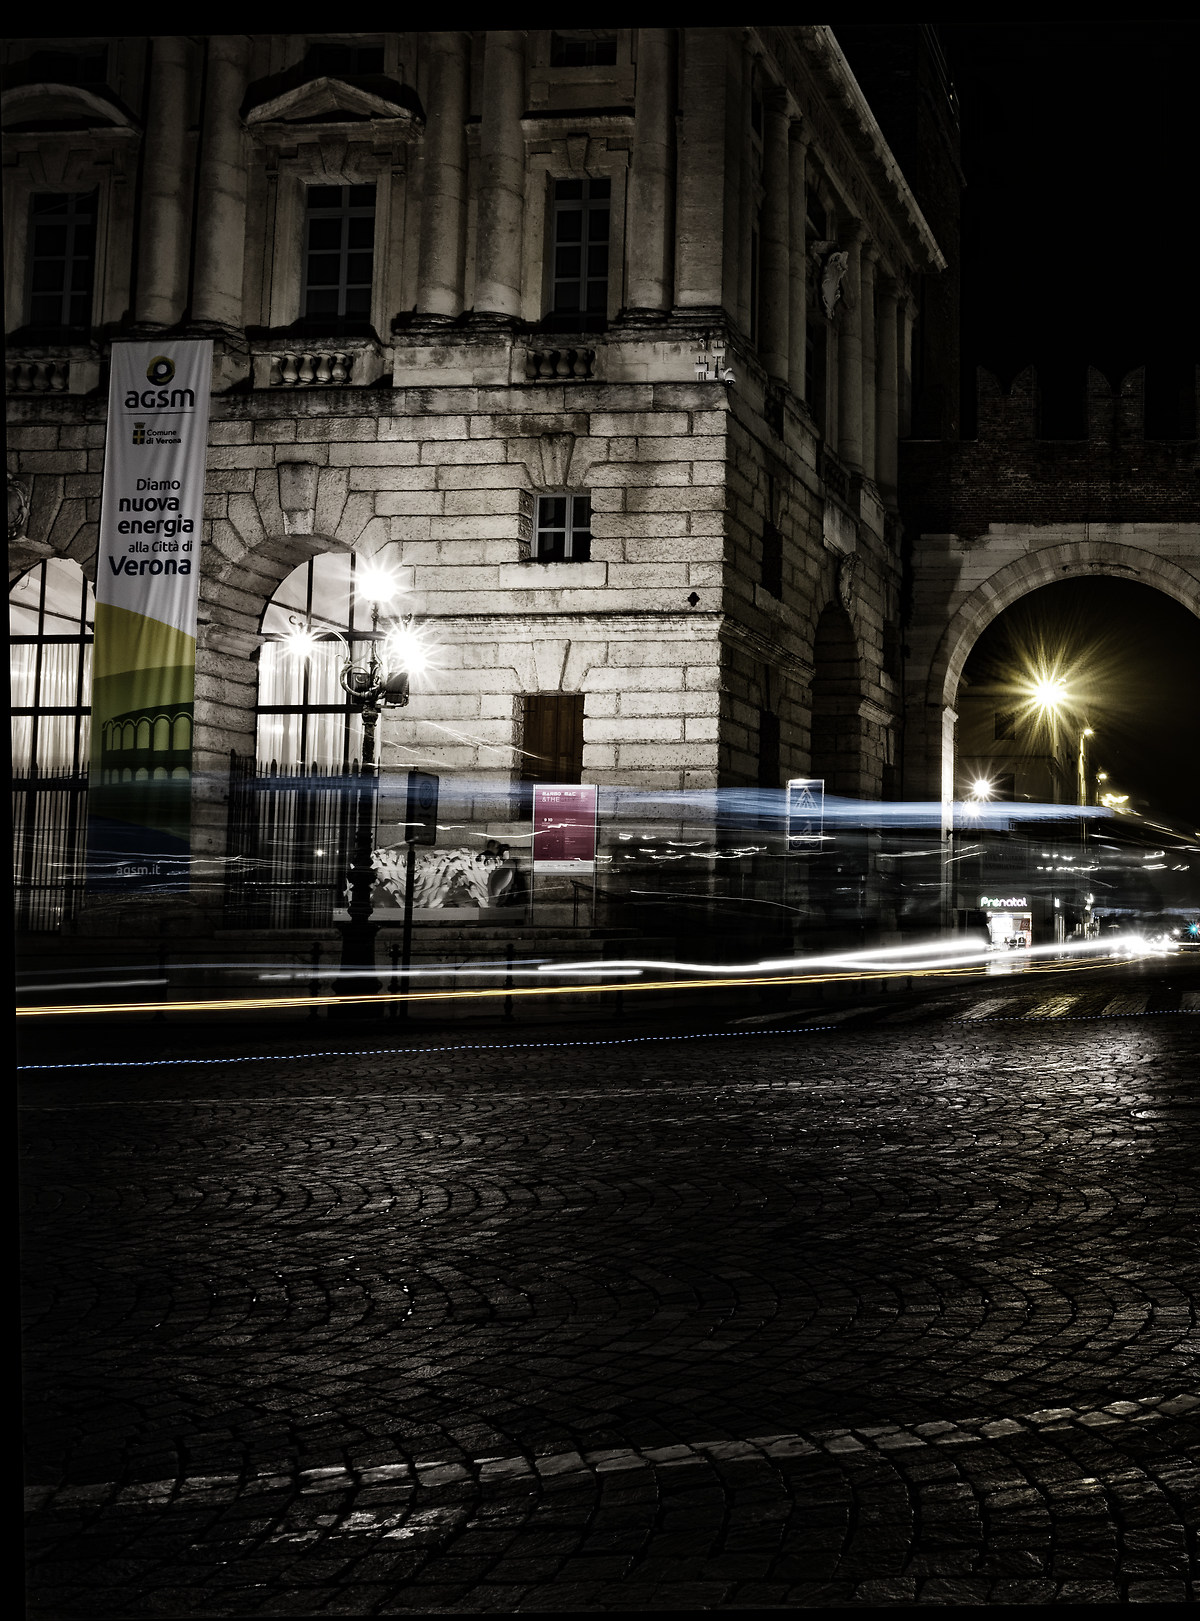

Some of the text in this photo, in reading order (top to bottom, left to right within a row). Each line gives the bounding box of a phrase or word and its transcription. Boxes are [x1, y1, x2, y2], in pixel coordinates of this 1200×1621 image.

[146, 437, 153, 445] di
[136, 478, 181, 491] Diamo
[119, 497, 180, 512] nuova
[118, 513, 194, 537] energia
[128, 540, 193, 553] alla Città di
[108, 555, 192, 576] Verona
[116, 864, 161, 876] agsm.it
